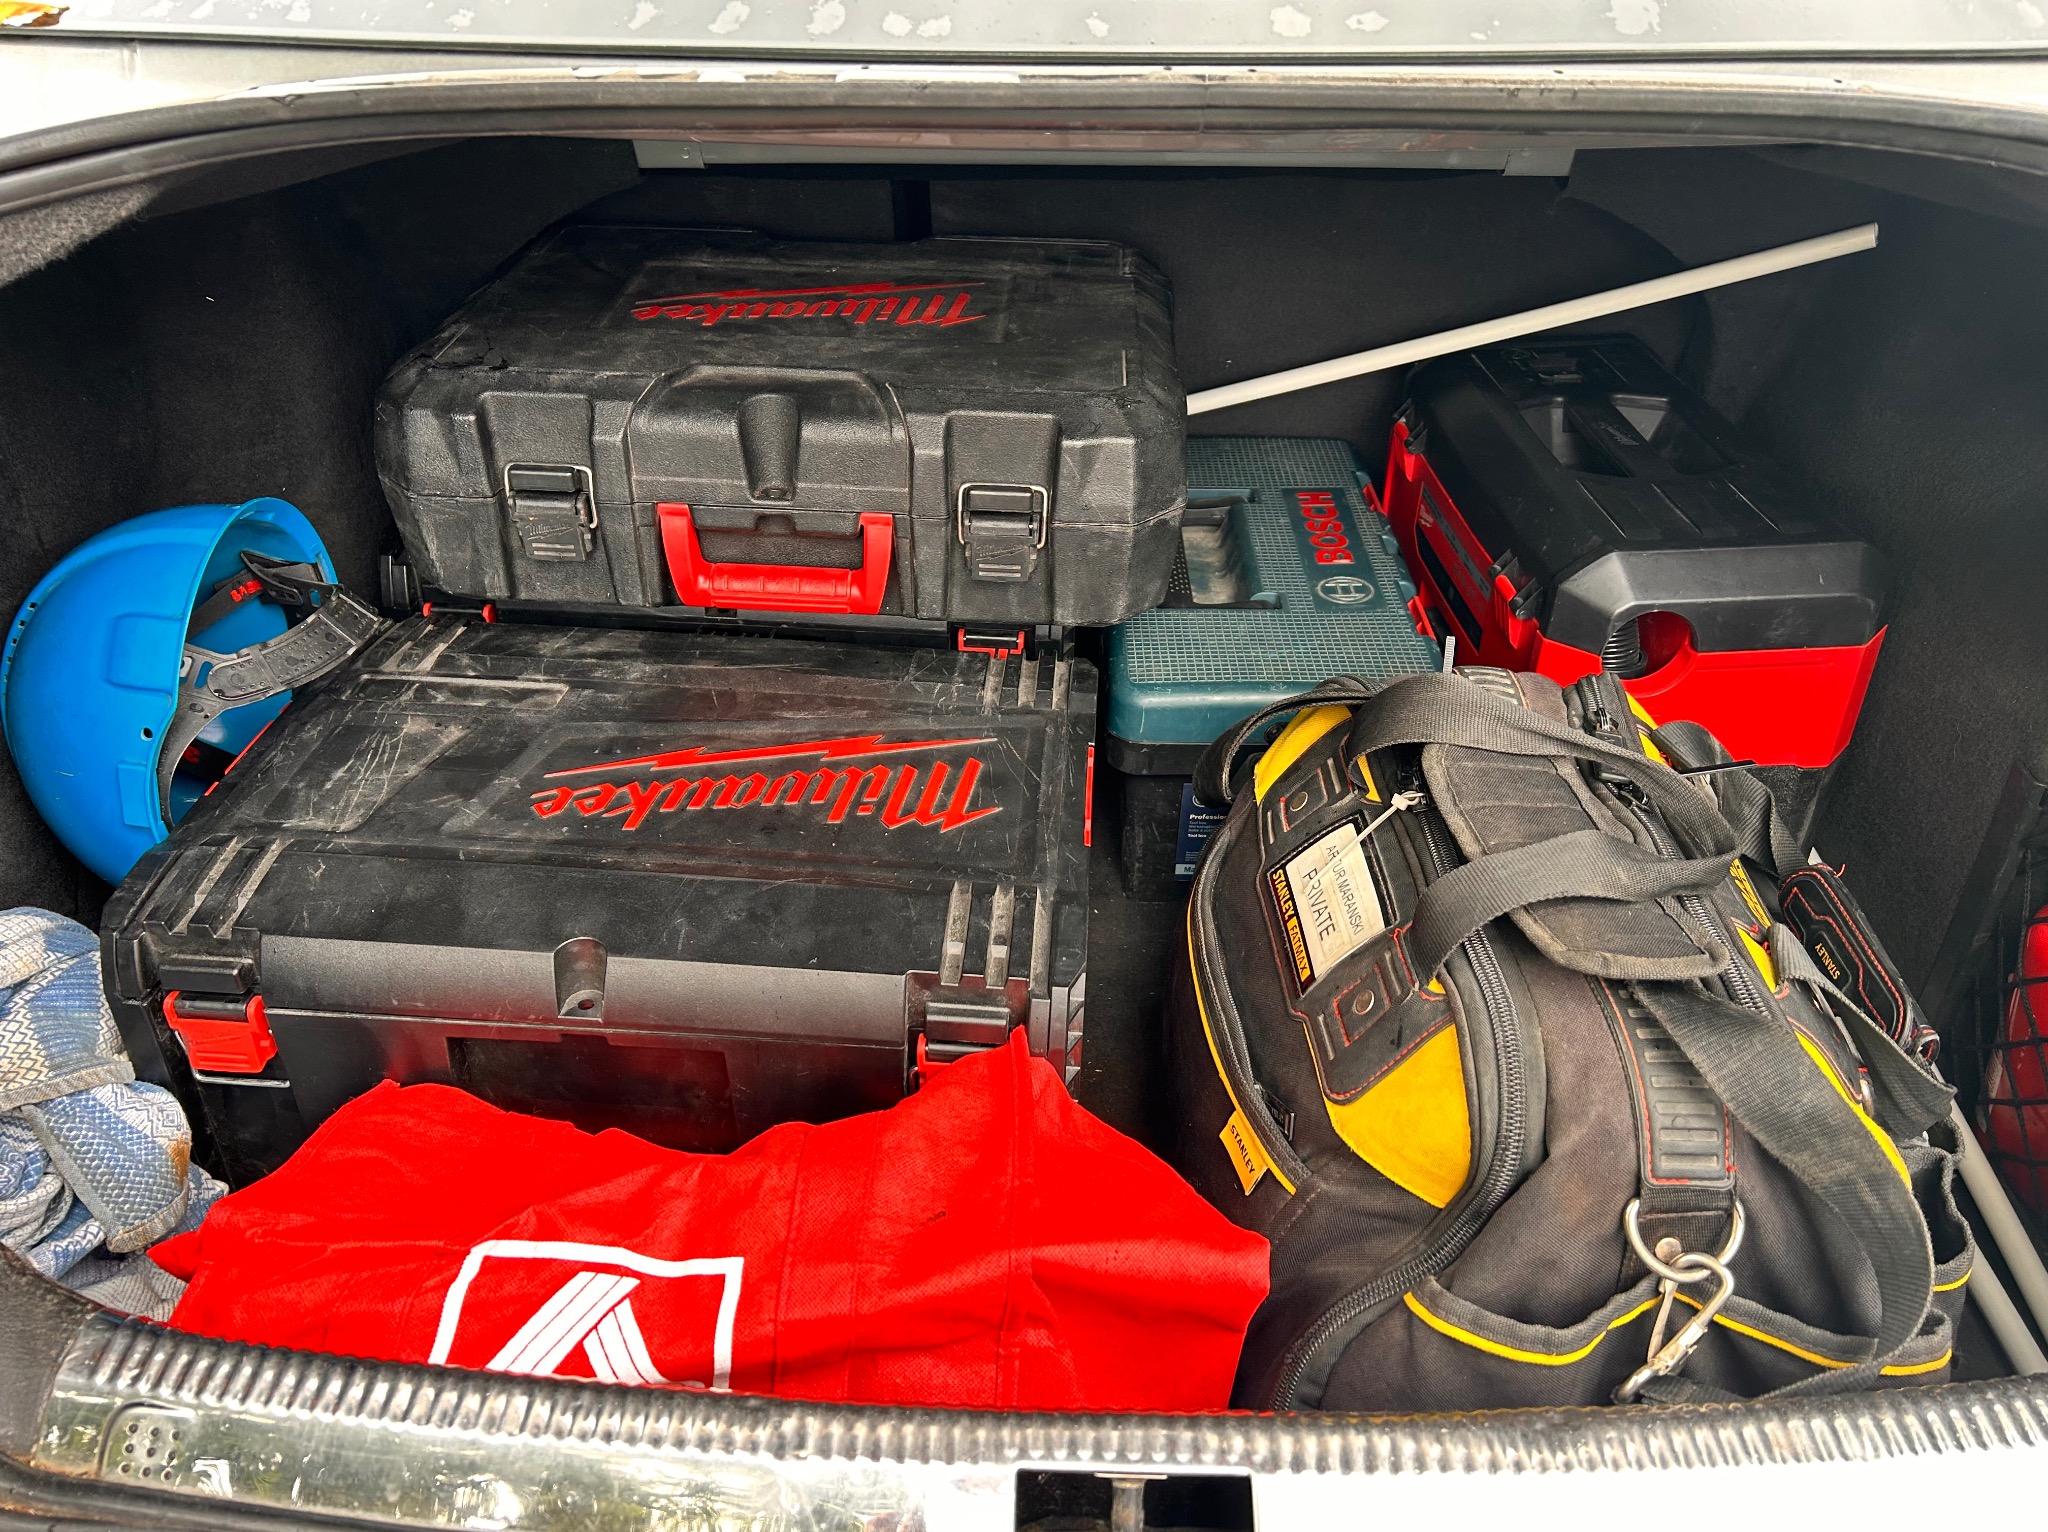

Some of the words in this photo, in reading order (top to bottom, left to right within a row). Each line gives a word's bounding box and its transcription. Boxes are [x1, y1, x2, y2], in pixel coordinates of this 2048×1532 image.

[630, 292, 987, 328] Milwaukee
[1296, 491, 1356, 565] BOSCH
[531, 757, 1003, 833] Milwaukee
[1272, 868, 1296, 921] STANLEY
[1289, 926, 1309, 975] FATMAX
[1302, 867, 1336, 941] PRIVATE
[1325, 845, 1346, 881] ARUR
[1337, 878, 1365, 936] MARANSKI
[1814, 942, 1841, 980] STANLEY
[1230, 1124, 1256, 1175] STANLEY
